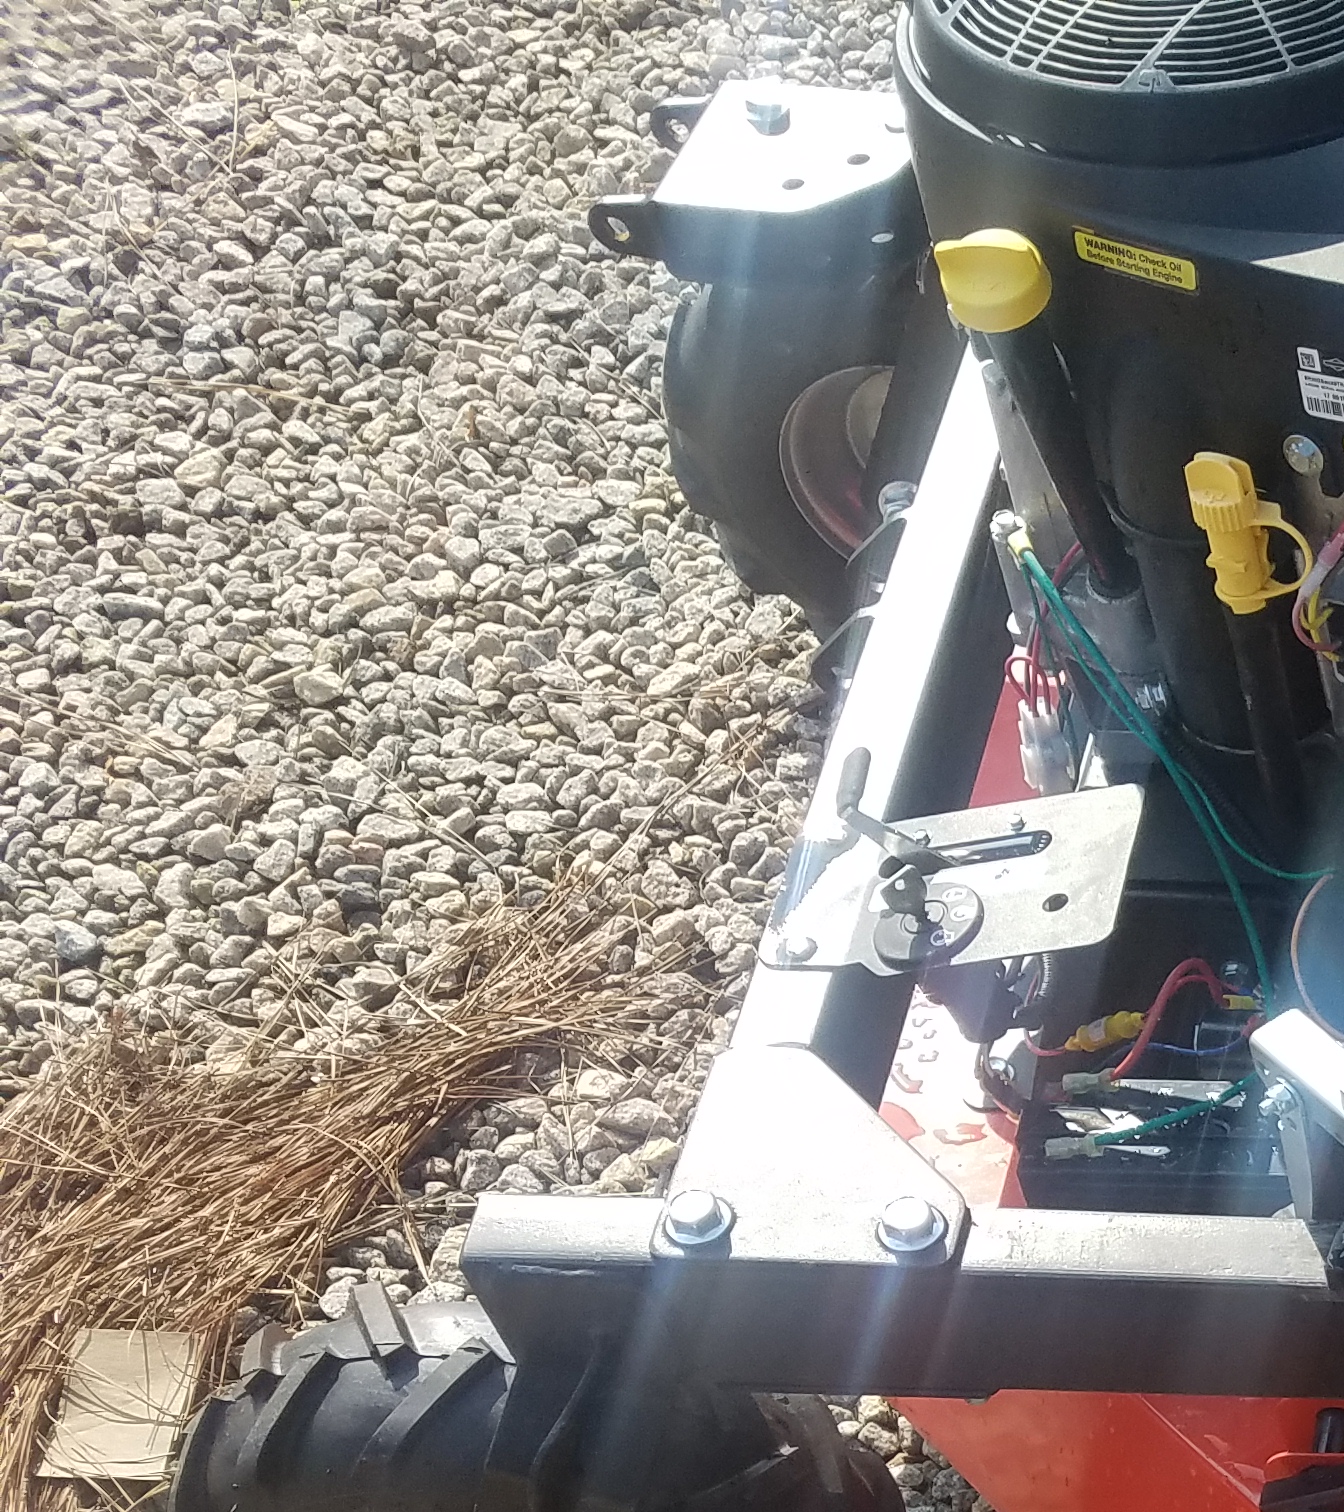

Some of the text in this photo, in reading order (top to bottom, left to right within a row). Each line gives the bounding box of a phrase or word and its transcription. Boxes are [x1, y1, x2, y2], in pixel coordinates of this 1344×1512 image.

[1084, 237, 1182, 272] WARNING: Check Oil
[1087, 249, 1183, 284] Before Starting Engine
